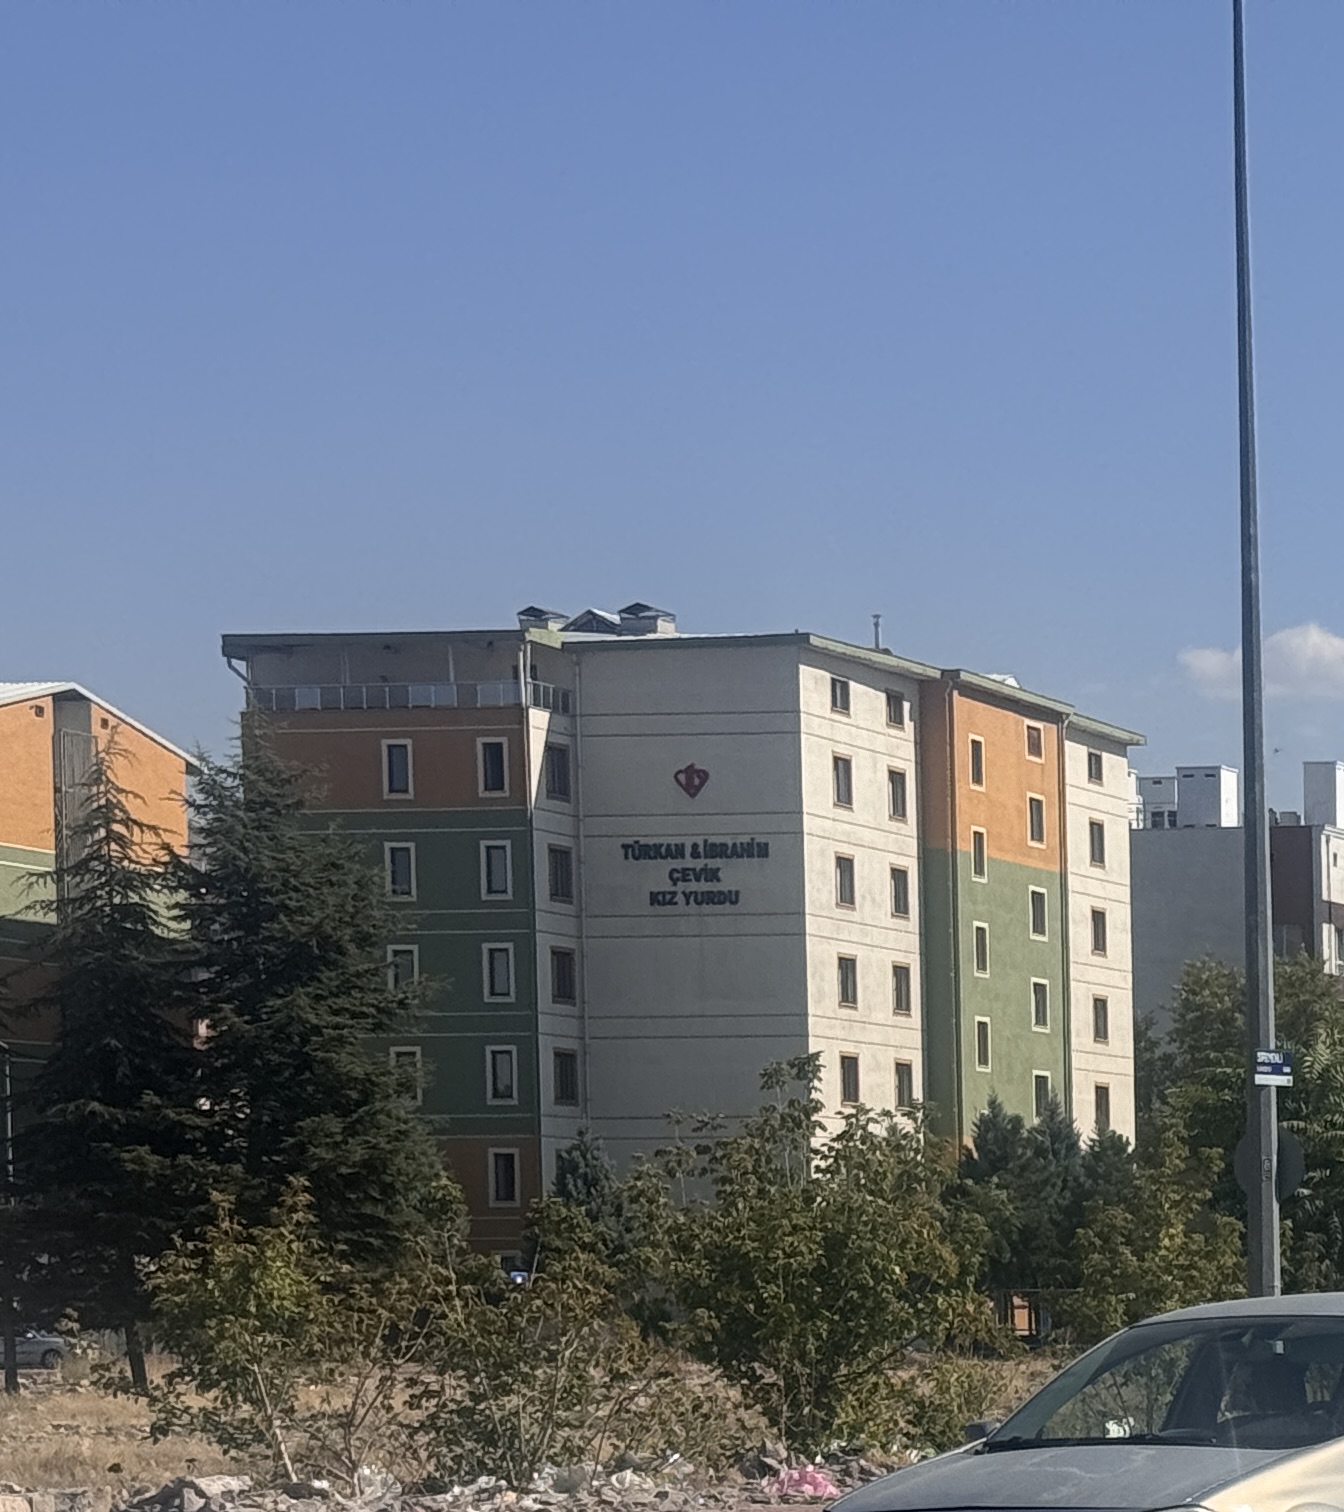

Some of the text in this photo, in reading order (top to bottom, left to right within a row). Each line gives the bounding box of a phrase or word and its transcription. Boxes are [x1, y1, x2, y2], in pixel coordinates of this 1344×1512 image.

[621, 838, 770, 861] TÜRKAN & İBRAHİM
[668, 863, 722, 887] ÇEVİK
[649, 890, 740, 907] KIZ YURDU
